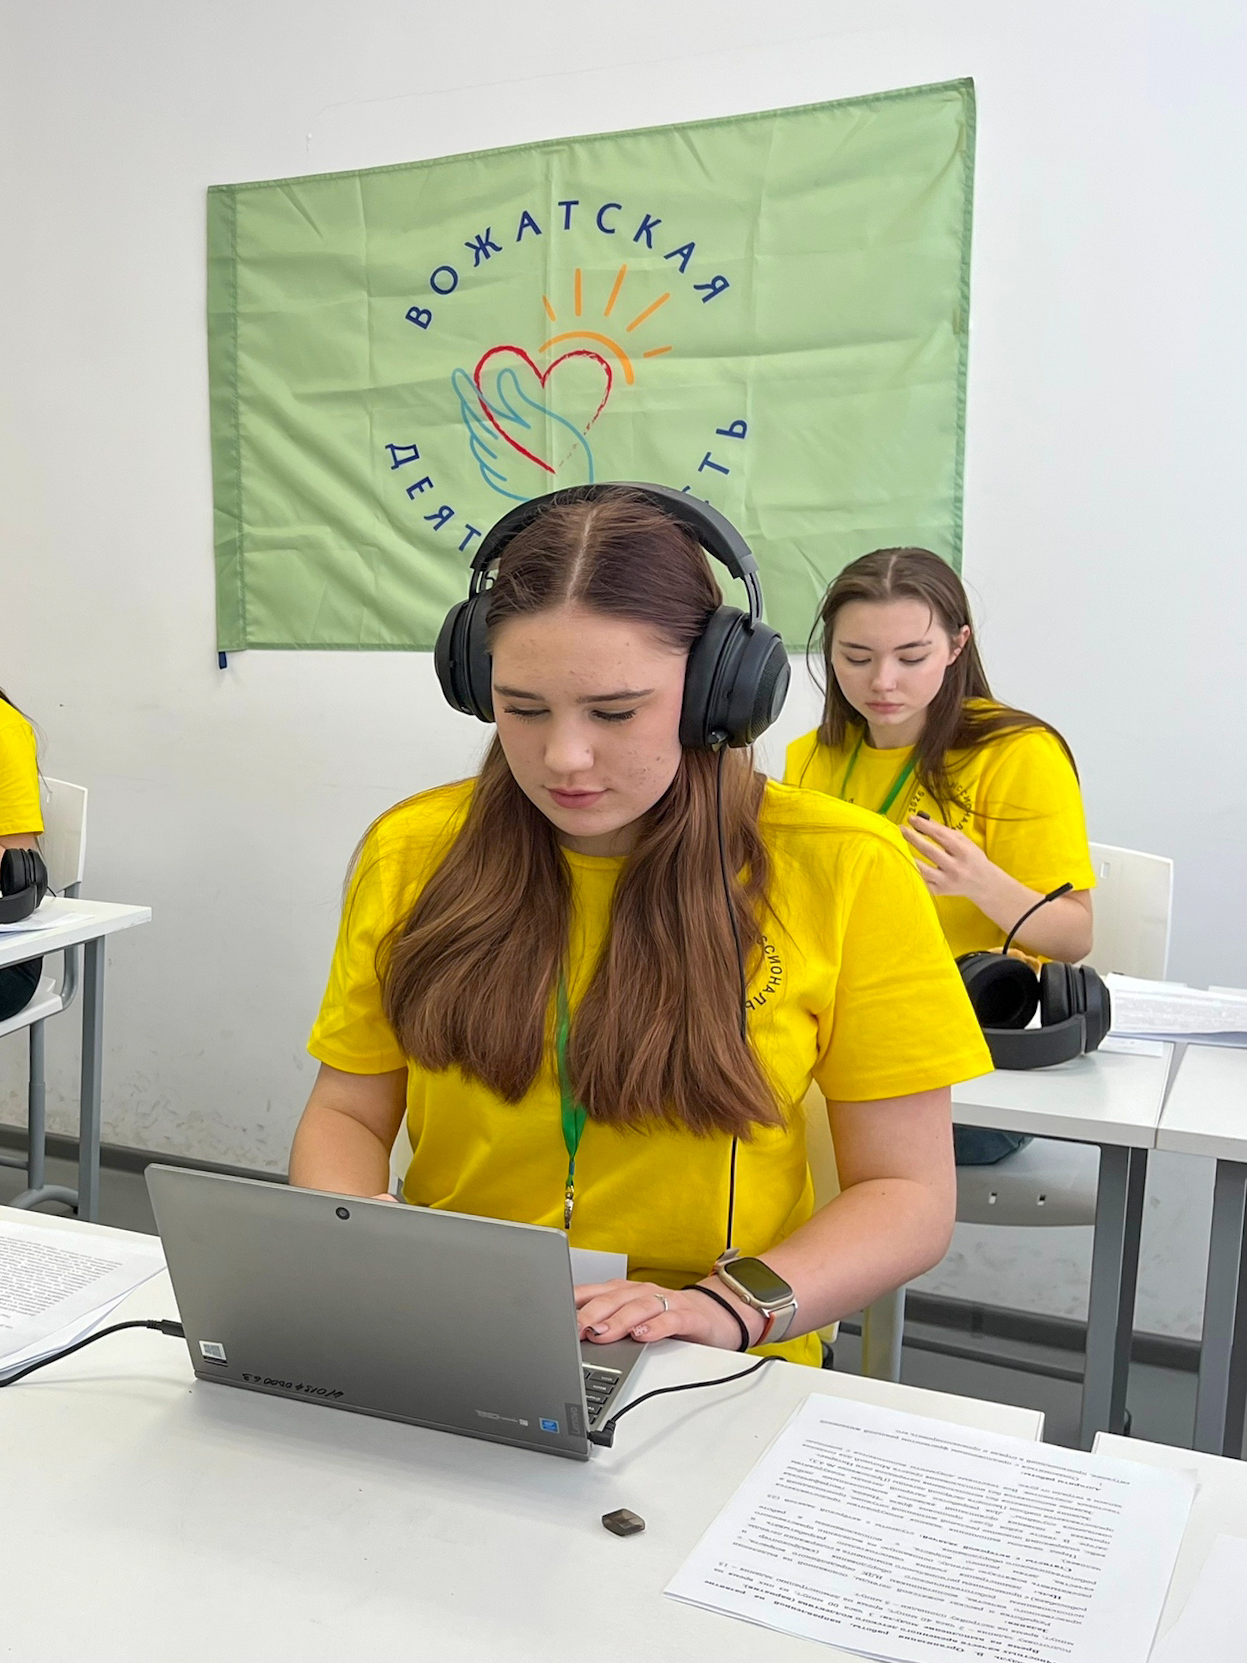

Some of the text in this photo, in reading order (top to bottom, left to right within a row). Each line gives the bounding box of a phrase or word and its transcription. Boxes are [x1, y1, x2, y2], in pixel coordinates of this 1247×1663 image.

[404, 199, 730, 331] ВОЖАТСКАЯ
[385, 418, 749, 552] ДЕЯТТЬ
[908, 790, 925, 813] 2026
